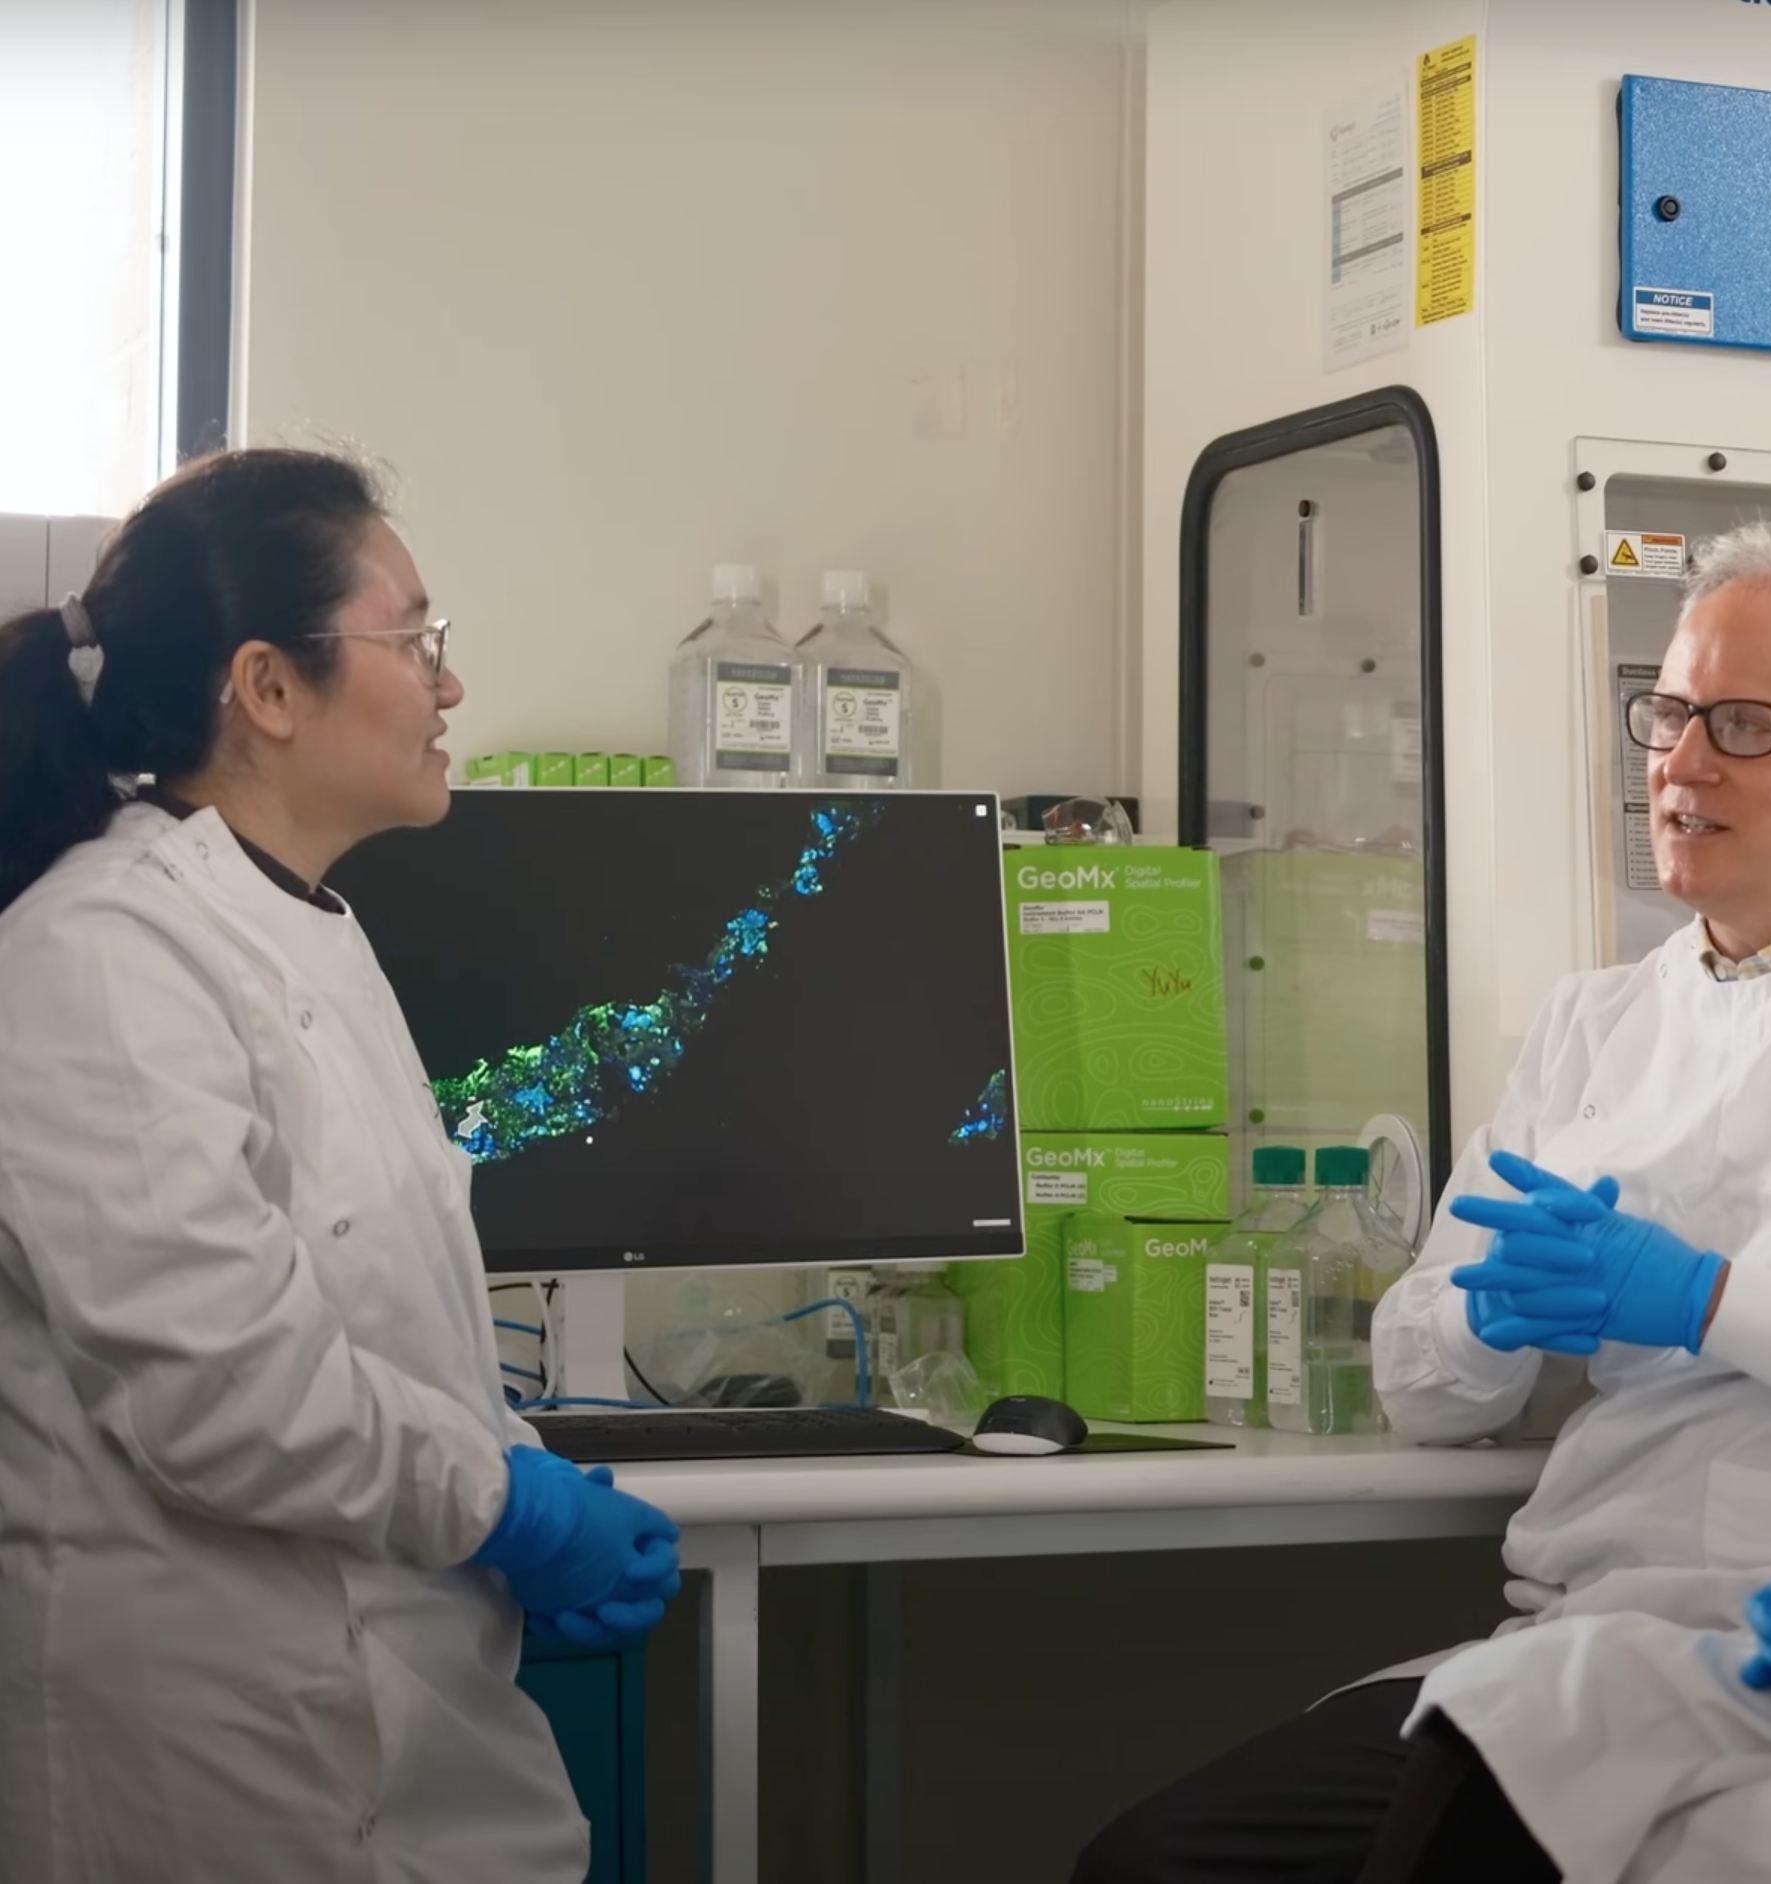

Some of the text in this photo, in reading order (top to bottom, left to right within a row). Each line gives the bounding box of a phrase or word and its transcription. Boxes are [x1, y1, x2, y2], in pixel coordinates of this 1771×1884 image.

[1653, 293, 1695, 307] NOTICE
[1017, 864, 1115, 889] GeoMx
[1124, 864, 1161, 877] Digital
[1124, 877, 1201, 889] Spatial Profiler
[1026, 1147, 1105, 1167] GeoMx
[1114, 1147, 1145, 1159] Digital
[1114, 1158, 1178, 1168] Spatial Profiler
[634, 1252, 645, 1261] LG
